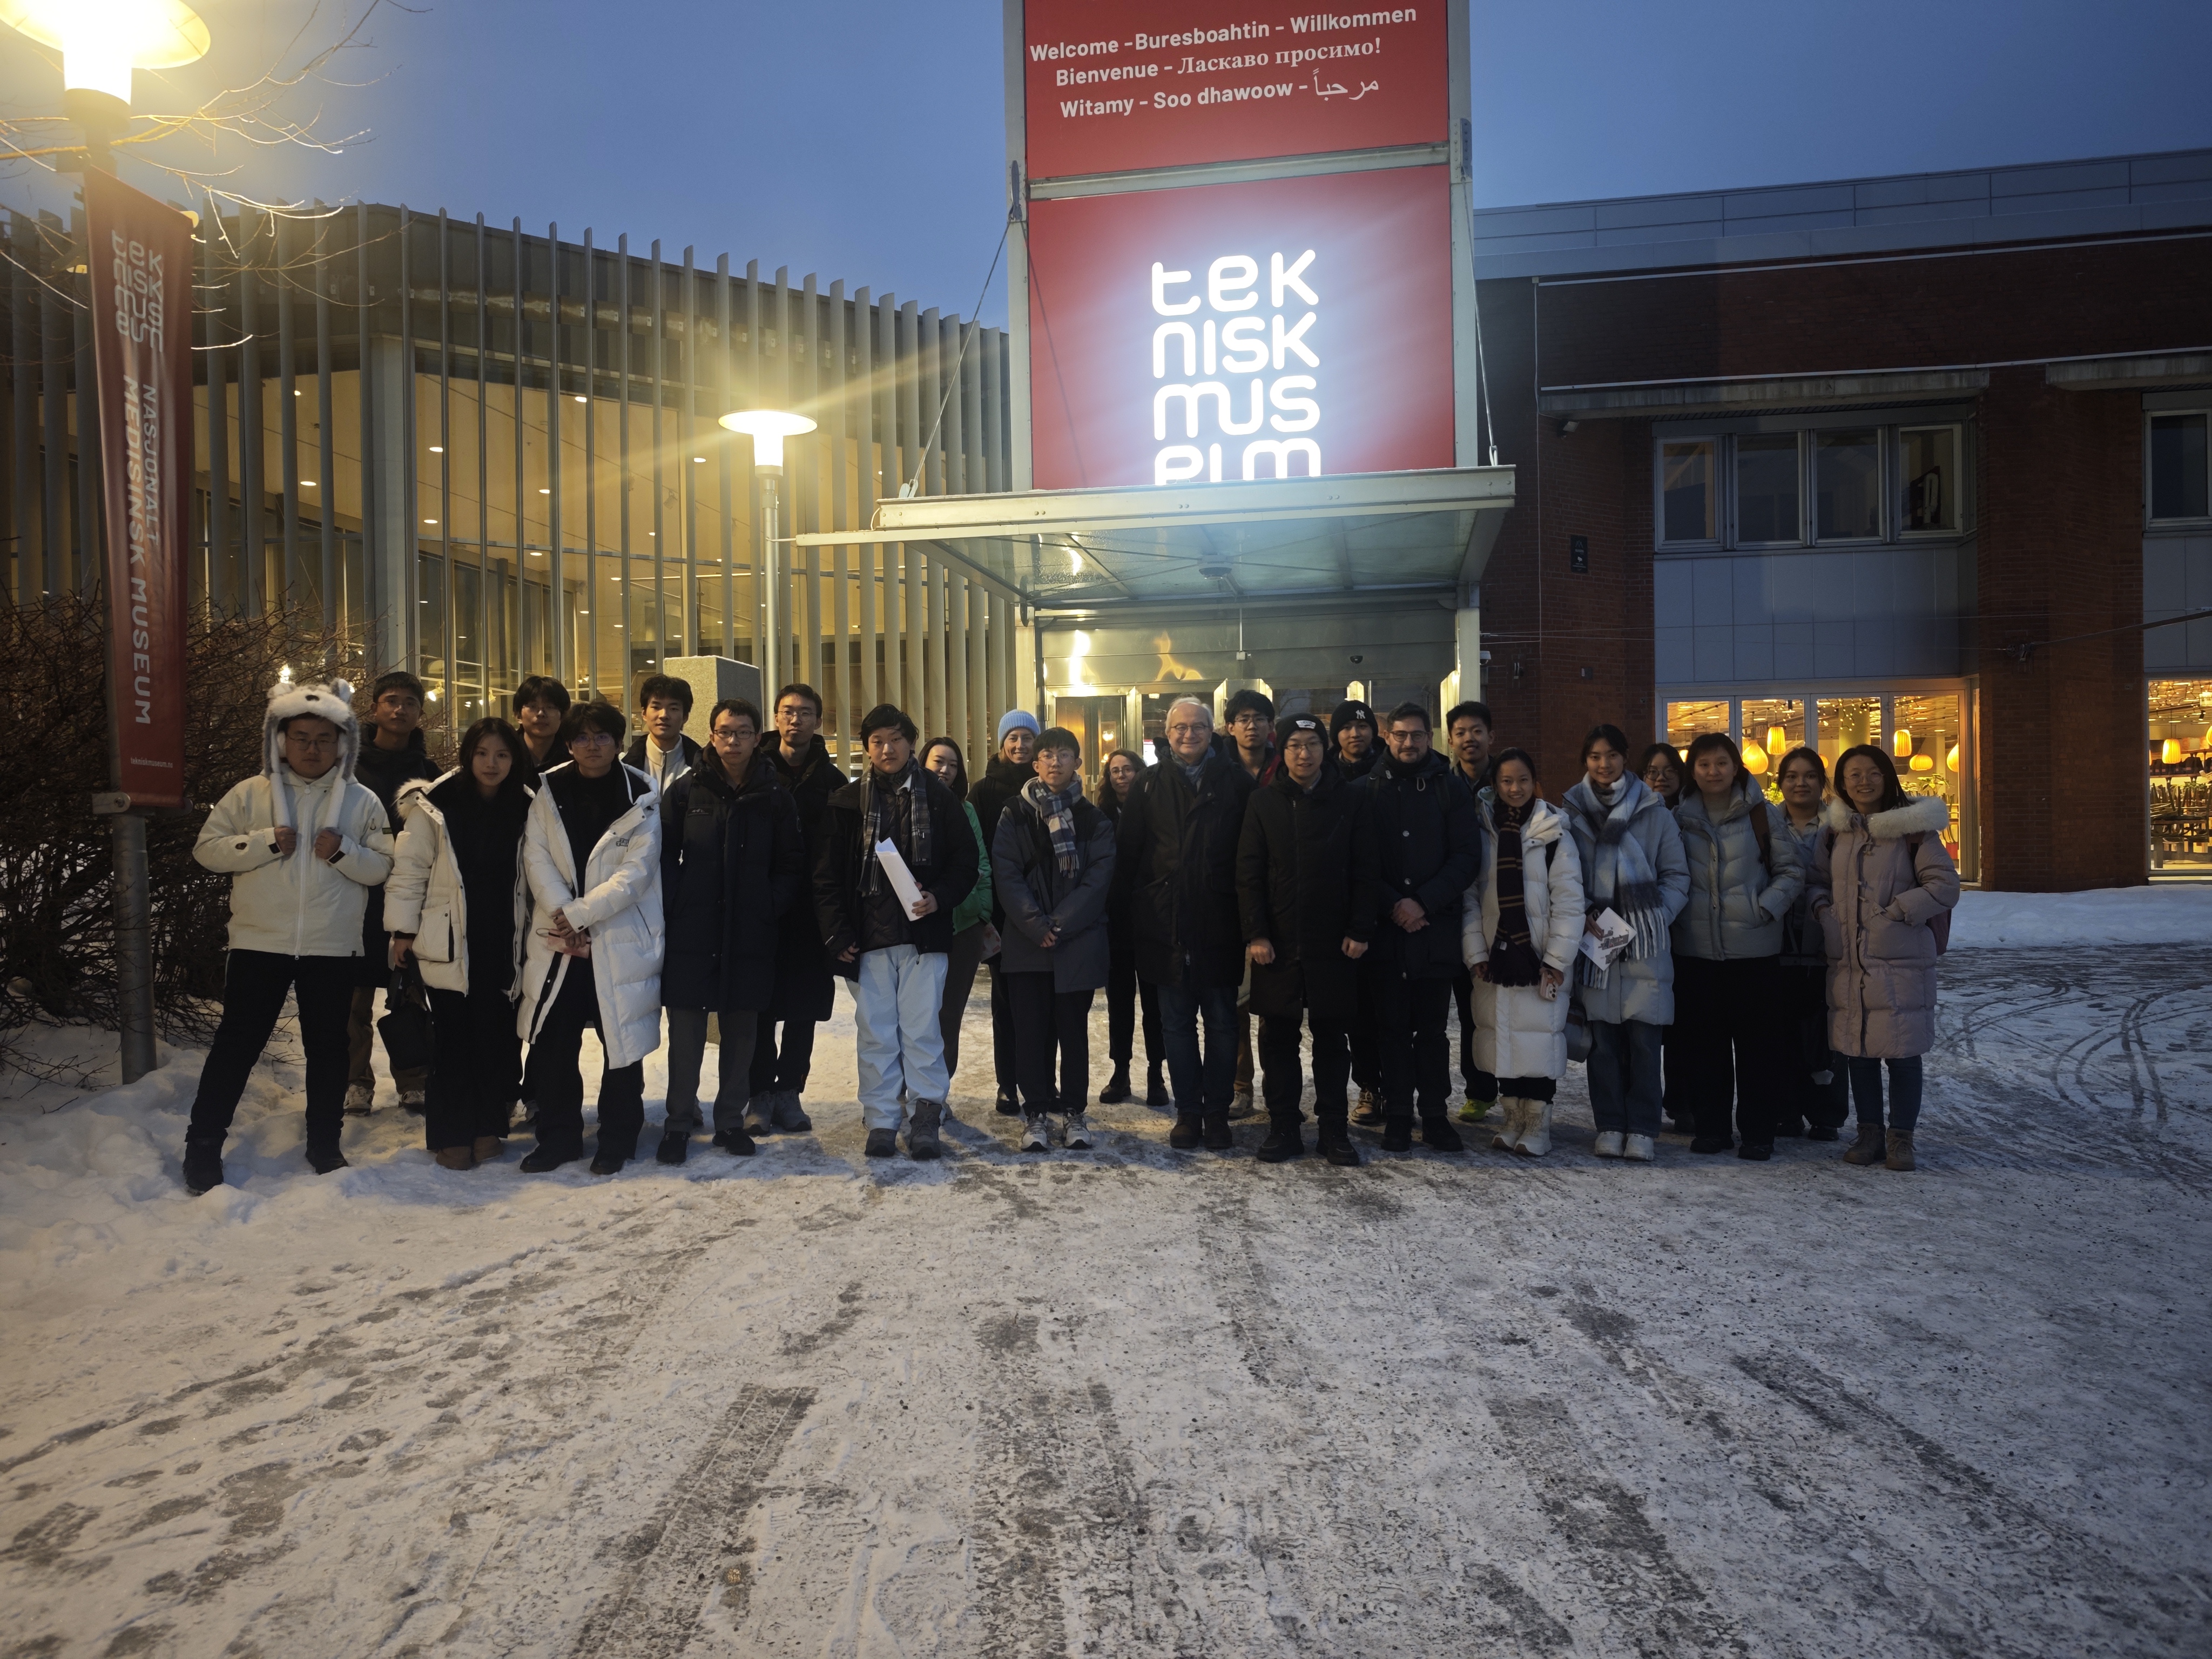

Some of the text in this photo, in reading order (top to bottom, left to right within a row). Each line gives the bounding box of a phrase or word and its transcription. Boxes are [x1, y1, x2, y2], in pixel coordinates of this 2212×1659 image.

[1029, 41, 1119, 62] Welcome
[1290, 8, 1417, 34] Willkommen
[1056, 64, 1158, 86] Bienvenue
[1177, 53, 1269, 75] Ласкаво
[1275, 37, 1380, 68] просимо!
[1060, 98, 1134, 118] Witamy
[1154, 91, 1191, 109] Soo
[1197, 84, 1293, 105] dhawoow
[143, 384, 159, 545] NASJONALT
[123, 374, 151, 725] MEDISINSK MUSEUM
